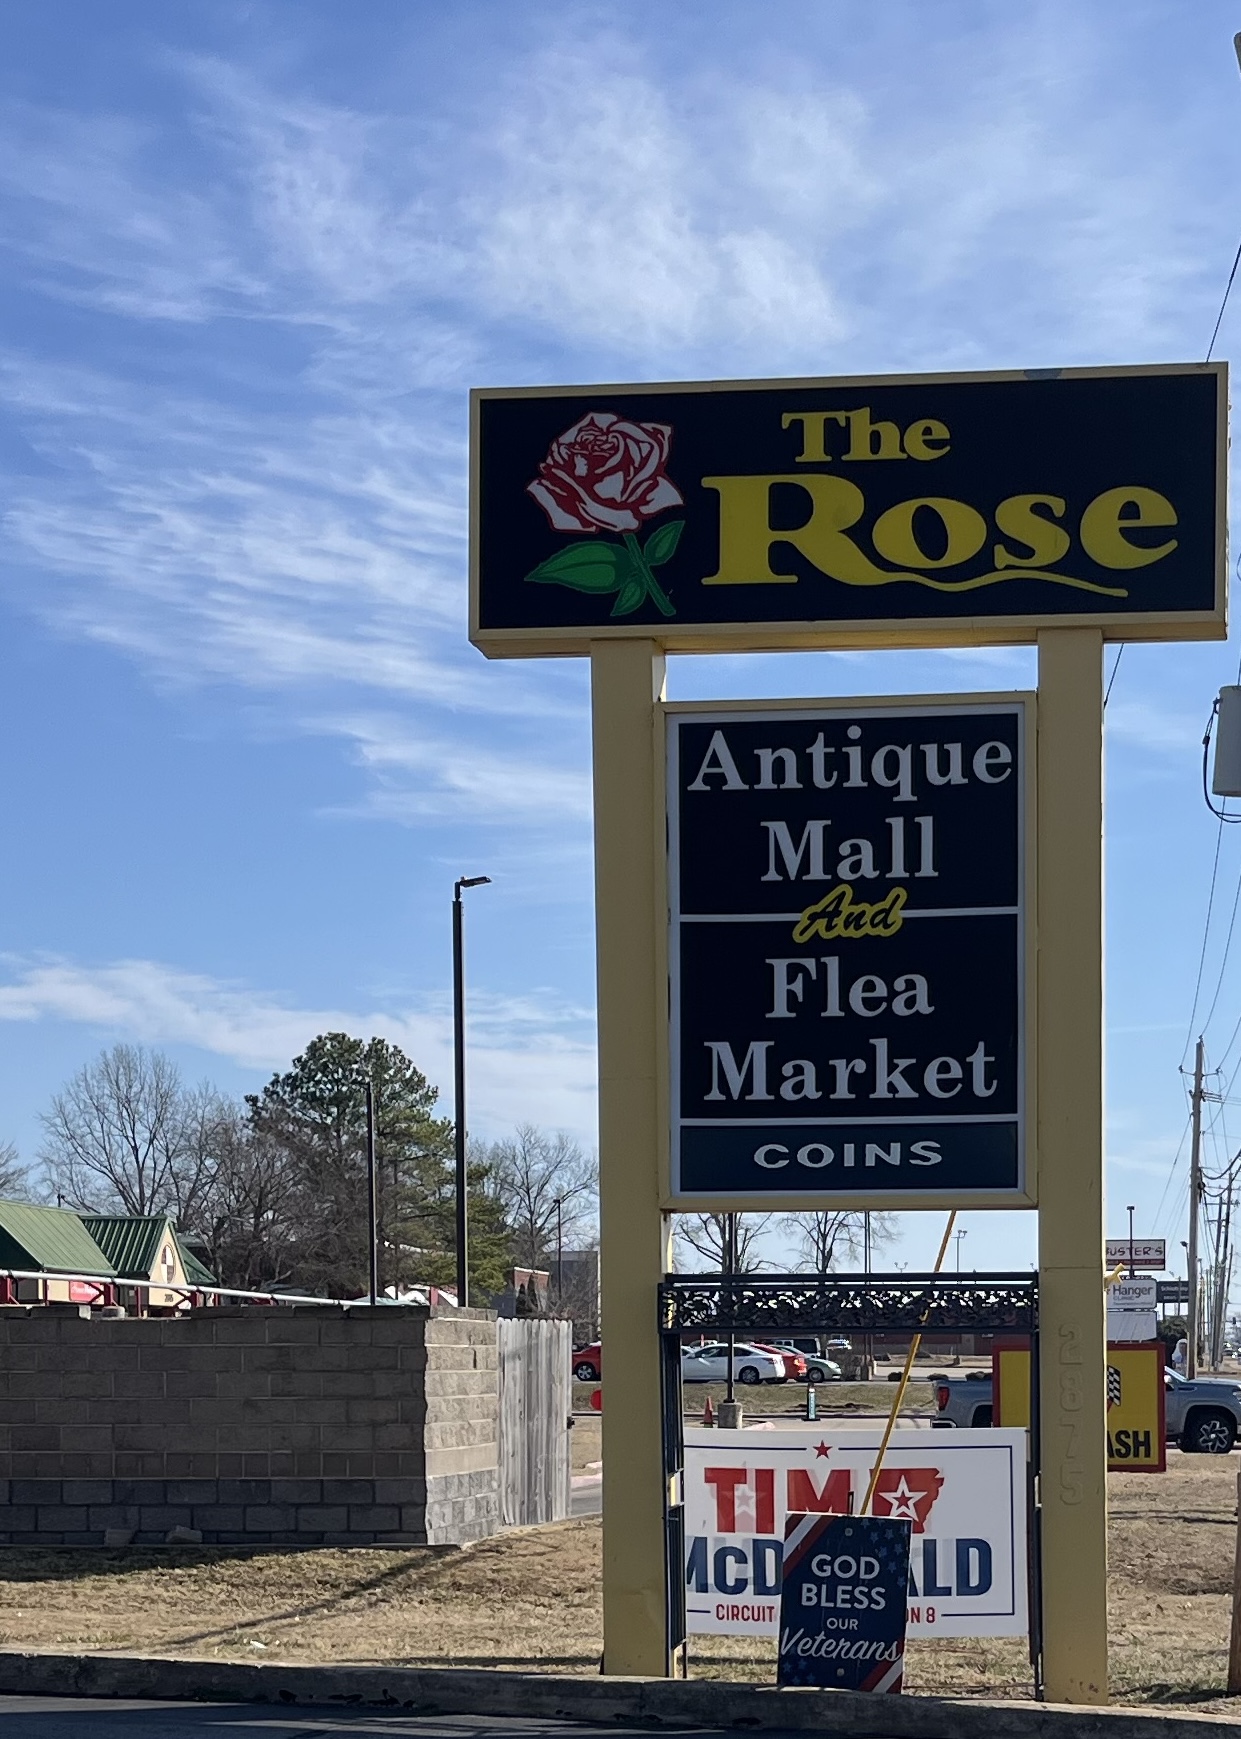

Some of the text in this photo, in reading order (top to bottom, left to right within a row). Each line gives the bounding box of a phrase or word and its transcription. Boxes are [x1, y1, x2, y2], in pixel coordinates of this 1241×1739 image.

[781, 406, 951, 463] The
[701, 473, 1178, 597] Rose
[687, 725, 1012, 802] Antique
[760, 815, 939, 881] Mall
[792, 884, 908, 943] And
[765, 956, 935, 1018] Flea
[703, 1037, 998, 1101] Market
[753, 1140, 942, 1169] COINS
[1112, 1285, 1153, 1298] Hanger
[704, 1467, 852, 1535] TIM
[811, 1553, 881, 1580] GOD
[715, 1604, 775, 1623] CIRCUIT
[925, 1606, 936, 1624] 8
[801, 1583, 886, 1611] BLESS
[826, 1617, 859, 1631] OUR
[779, 1626, 903, 1662] Veterans
